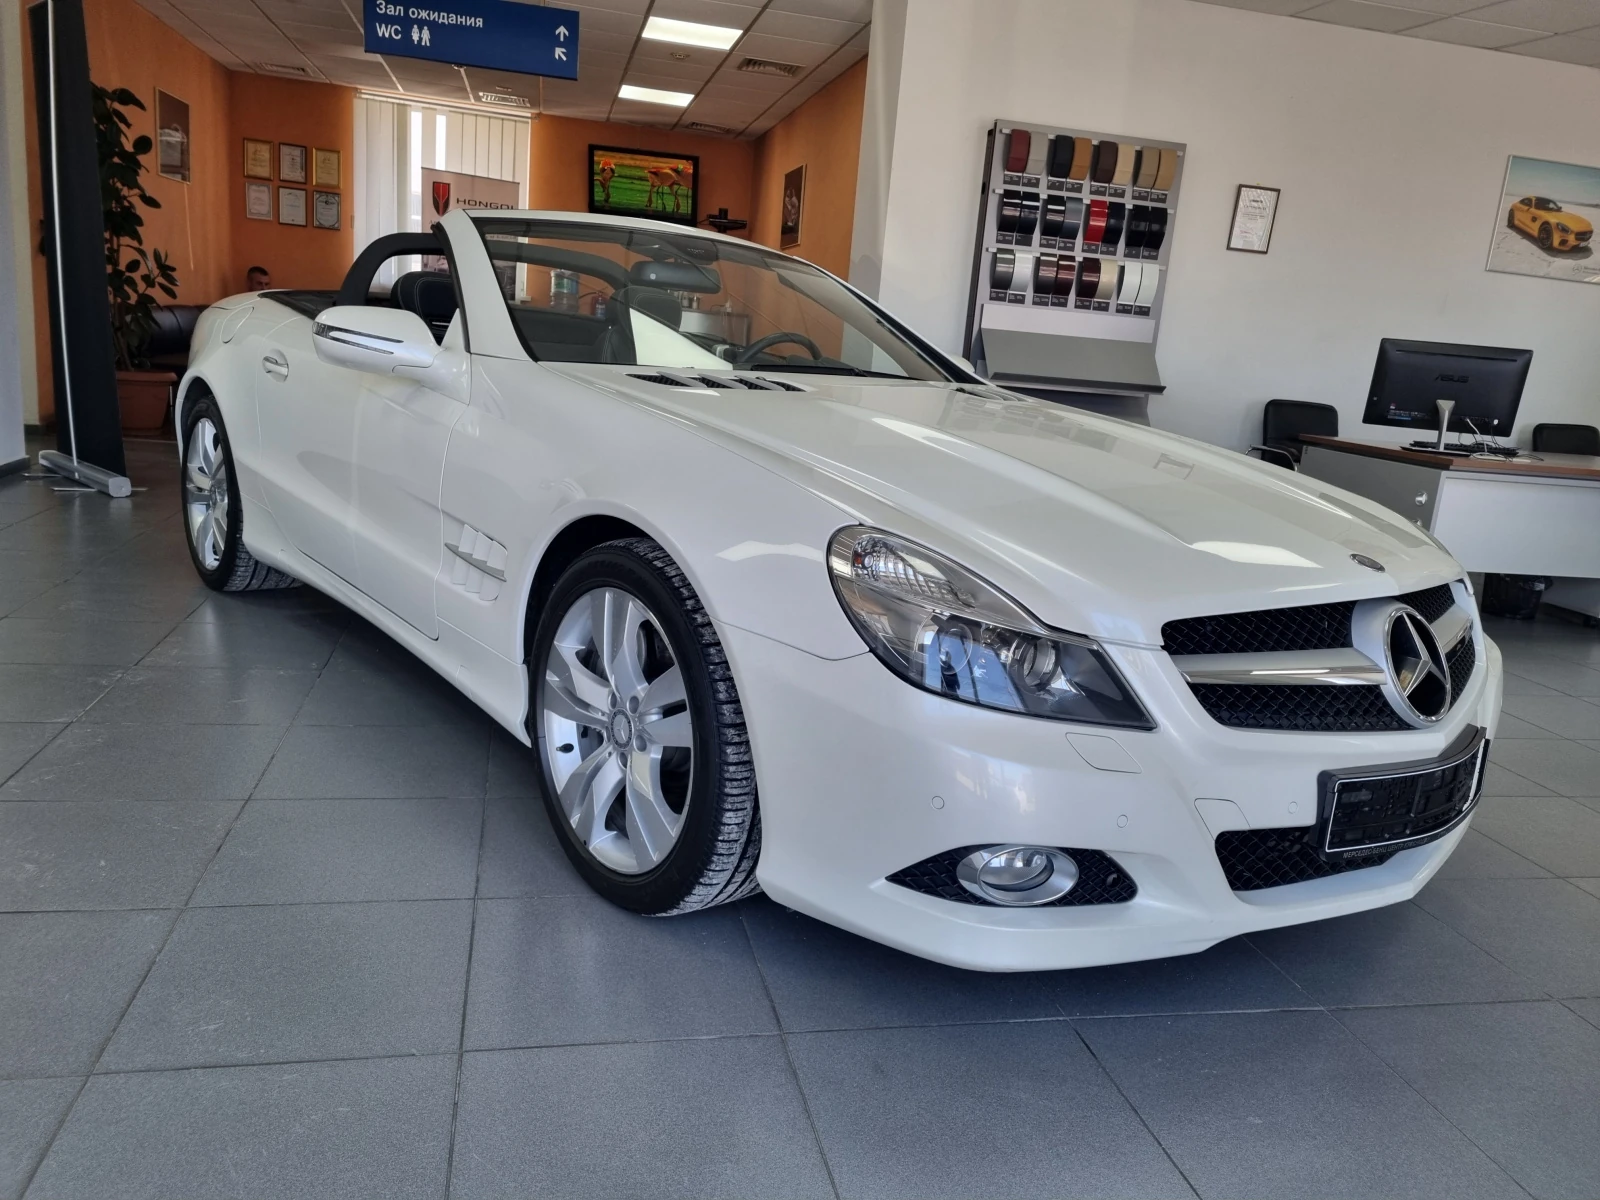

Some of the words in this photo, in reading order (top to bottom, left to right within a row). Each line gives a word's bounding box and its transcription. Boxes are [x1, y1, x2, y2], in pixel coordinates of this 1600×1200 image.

[376, 0, 404, 17] Зал
[408, 8, 484, 28] ожидания
[376, 22, 402, 40] WC
[1433, 373, 1470, 384] ASUS
